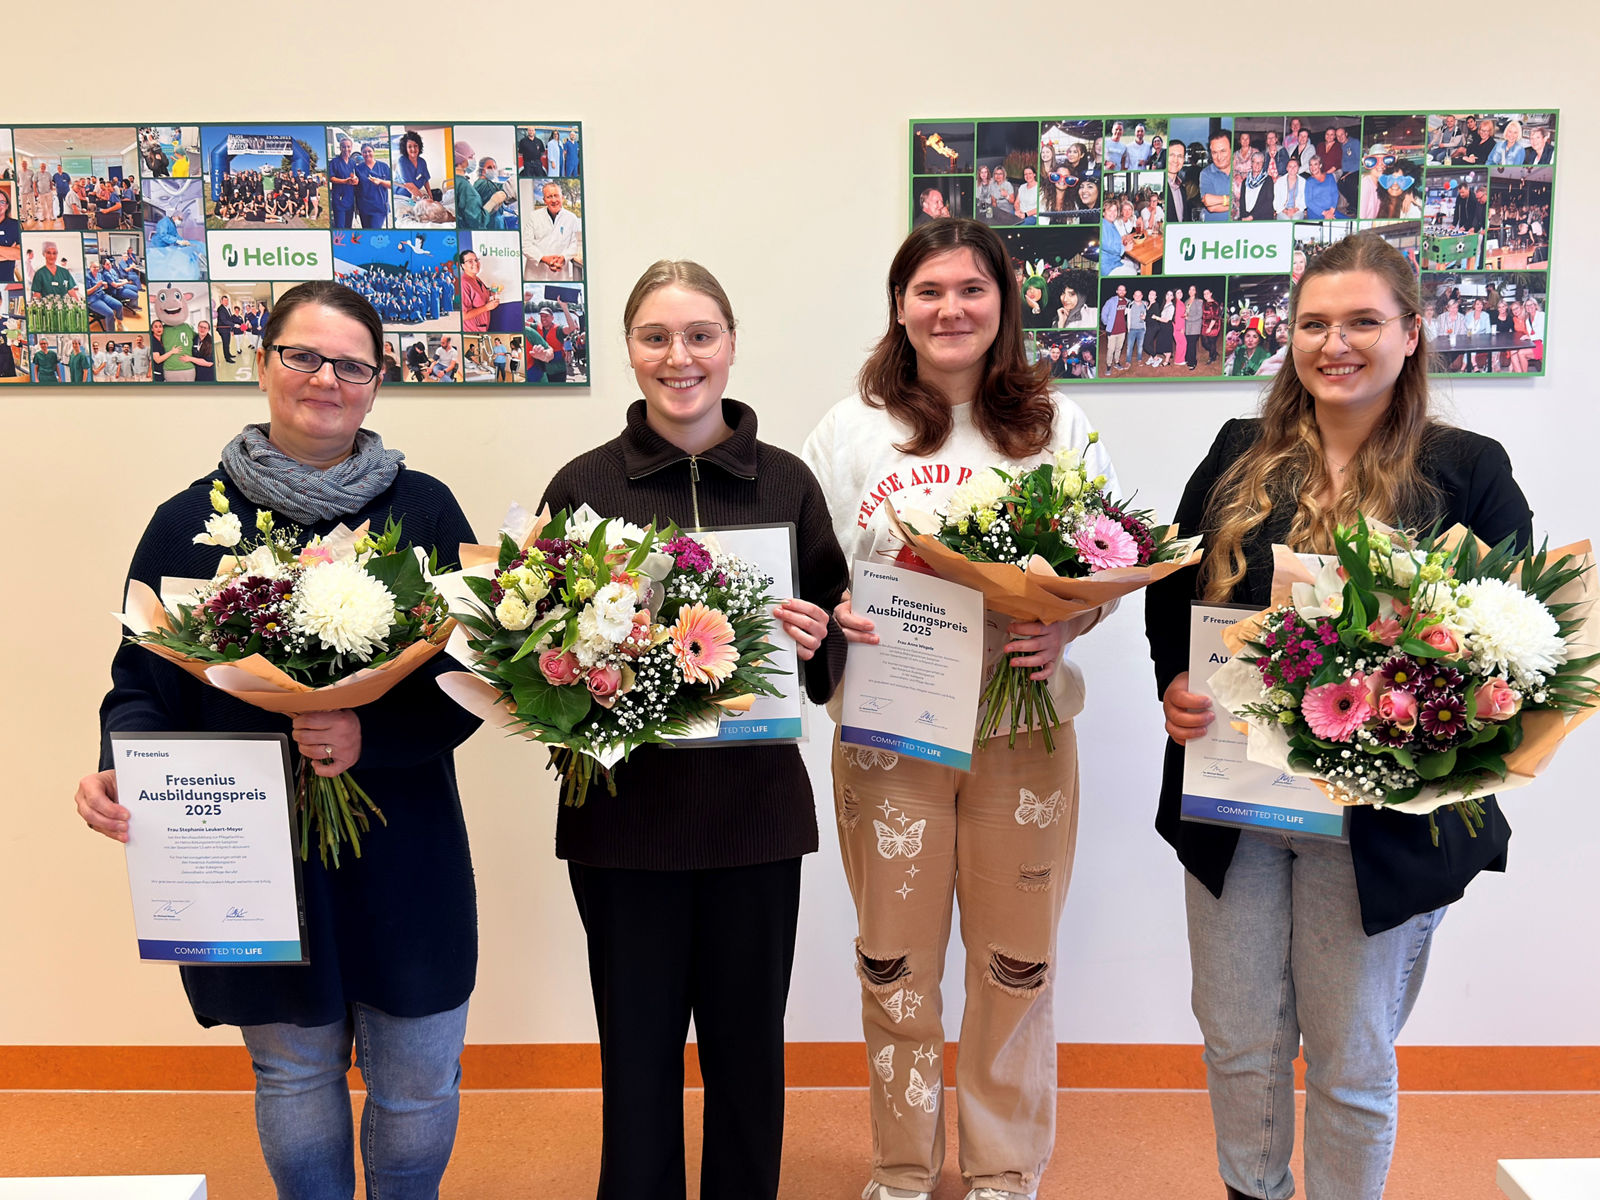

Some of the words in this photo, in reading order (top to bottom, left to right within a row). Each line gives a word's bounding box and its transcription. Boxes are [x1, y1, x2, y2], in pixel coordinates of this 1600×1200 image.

[489, 247, 521, 257] Helios
[1201, 239, 1277, 259] Helios
[243, 247, 319, 267] Helios
[857, 472, 904, 530] PEACE
[911, 464, 950, 487] AND
[956, 466, 973, 486] R
[869, 571, 899, 582] Fresenius
[891, 595, 946, 616] Fresenius
[866, 605, 968, 633] Ausbildungspreis
[1210, 617, 1238, 625] Freseni
[902, 622, 932, 637] 2025
[739, 726, 751, 734] TO
[752, 725, 768, 733] LIFE
[871, 735, 915, 751] COMMITTED
[916, 745, 927, 753] TO
[927, 747, 941, 757] LIFE
[133, 750, 170, 758] Fresenius
[165, 773, 236, 786] Fresenius
[138, 789, 267, 803] Ausbildungspreis
[185, 804, 222, 816] 2025
[1216, 805, 1271, 819] COMMITTED
[1272, 812, 1285, 821] TO
[1286, 815, 1304, 825] LIFE
[174, 947, 229, 955] COMMITTED
[230, 947, 244, 955] TO
[245, 947, 263, 955] LIFE
